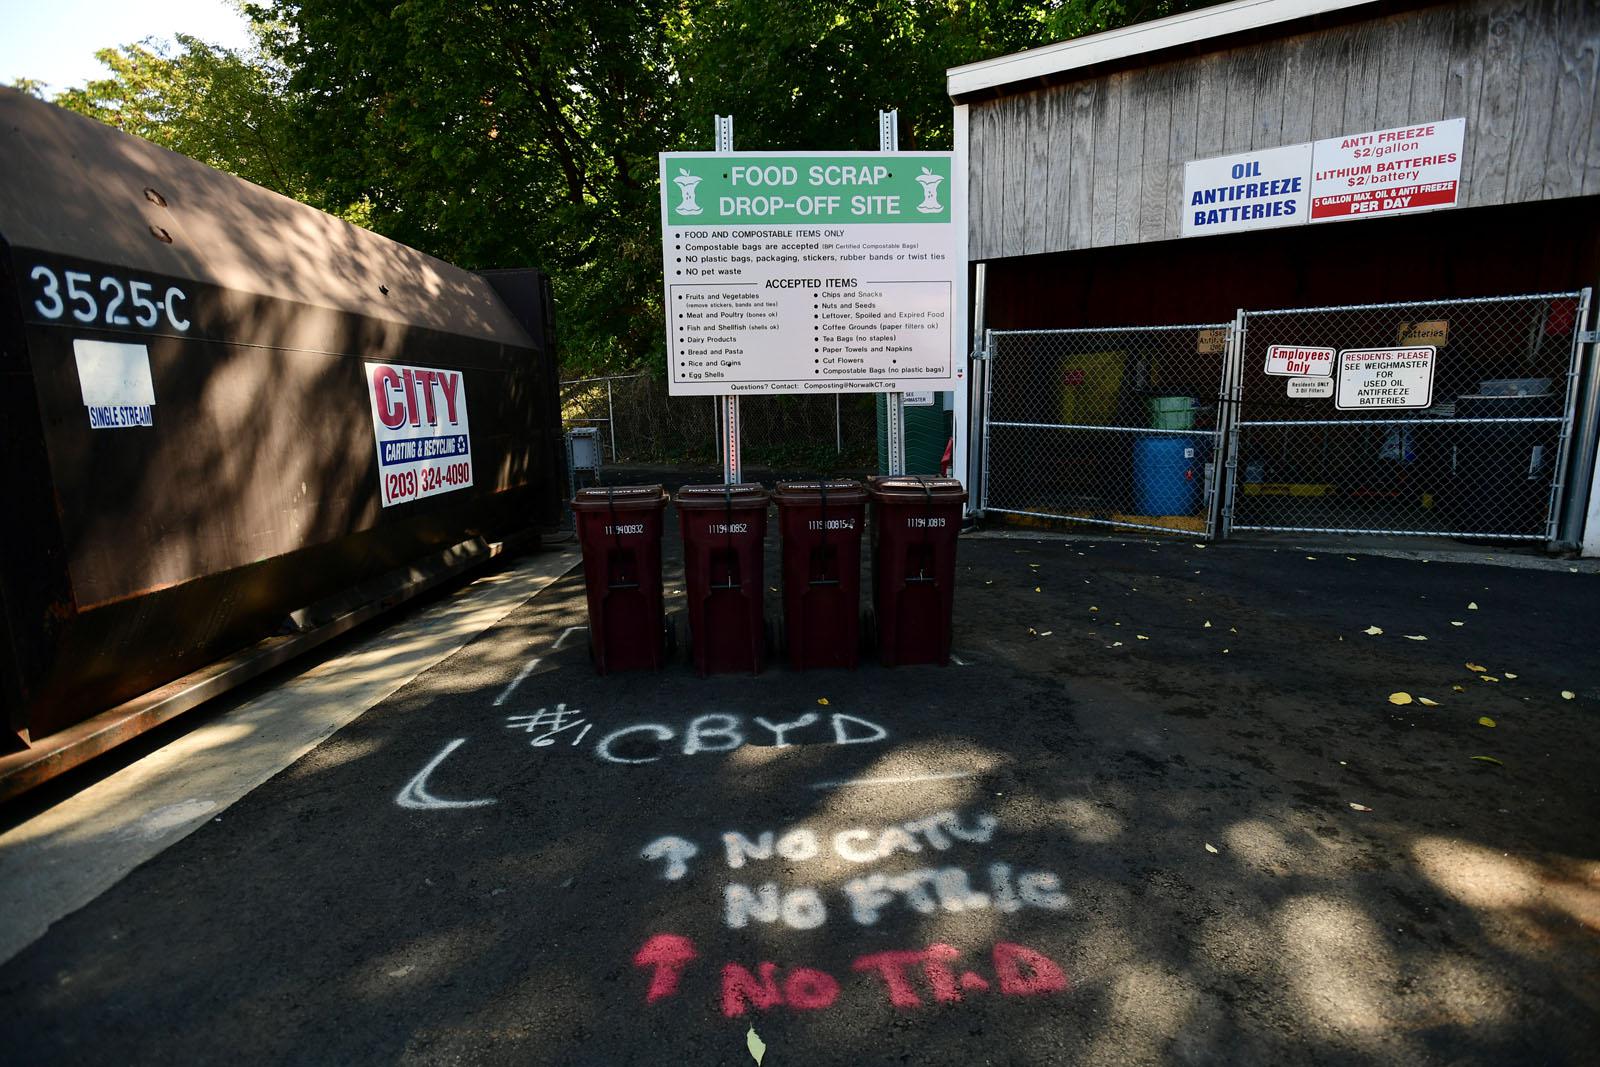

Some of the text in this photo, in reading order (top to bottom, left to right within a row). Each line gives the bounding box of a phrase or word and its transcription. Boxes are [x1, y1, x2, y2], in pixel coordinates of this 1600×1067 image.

[1341, 126, 1434, 149] ANTI FREEZE
[1354, 141, 1418, 159] $2/gallon
[732, 166, 888, 186] FOOD SCRAP
[1232, 161, 1262, 180] OIL
[1316, 153, 1457, 181] LITHIUM BATTERIES
[1348, 171, 1419, 187] $2/battery
[1191, 177, 1301, 206] ANTIFREEZE
[1315, 199, 1320, 207] 5
[1322, 195, 1351, 205] GALLON
[1354, 193, 1373, 201] MAX.
[1375, 190, 1388, 198] OIL
[1398, 186, 1417, 195] ANTI
[1420, 182, 1453, 193] FREEZE
[719, 195, 900, 216] DROP-OFF SITE
[1194, 200, 1297, 226] BATTERIES
[1351, 197, 1411, 213] PER DAY
[796, 230, 821, 238] ITEMS
[781, 243, 819, 251] accepted
[701, 255, 727, 263] plastic
[702, 268, 714, 276] pet
[765, 278, 857, 288] ACCEPTED ITEMS
[31, 266, 190, 332] 3525-C
[880, 323, 902, 331] (paper
[1272, 348, 1330, 361] Employees
[1346, 353, 1393, 361] RESIDENTS:
[823, 367, 867, 375] Compostable
[1287, 361, 1310, 375] Only
[1365, 361, 1428, 369] WEIGHMASTER
[373, 366, 460, 430] CITY
[1358, 388, 1409, 396] ANTIFREEZE
[90, 405, 150, 426] SINGLE STREAM
[386, 439, 455, 462] CARTING & RECYCLING
[386, 463, 469, 503] (203) 324-4090
[598, 713, 887, 764] CBYD
[722, 828, 818, 869] NO
[724, 881, 826, 929] NO
[721, 962, 840, 1018] NO
